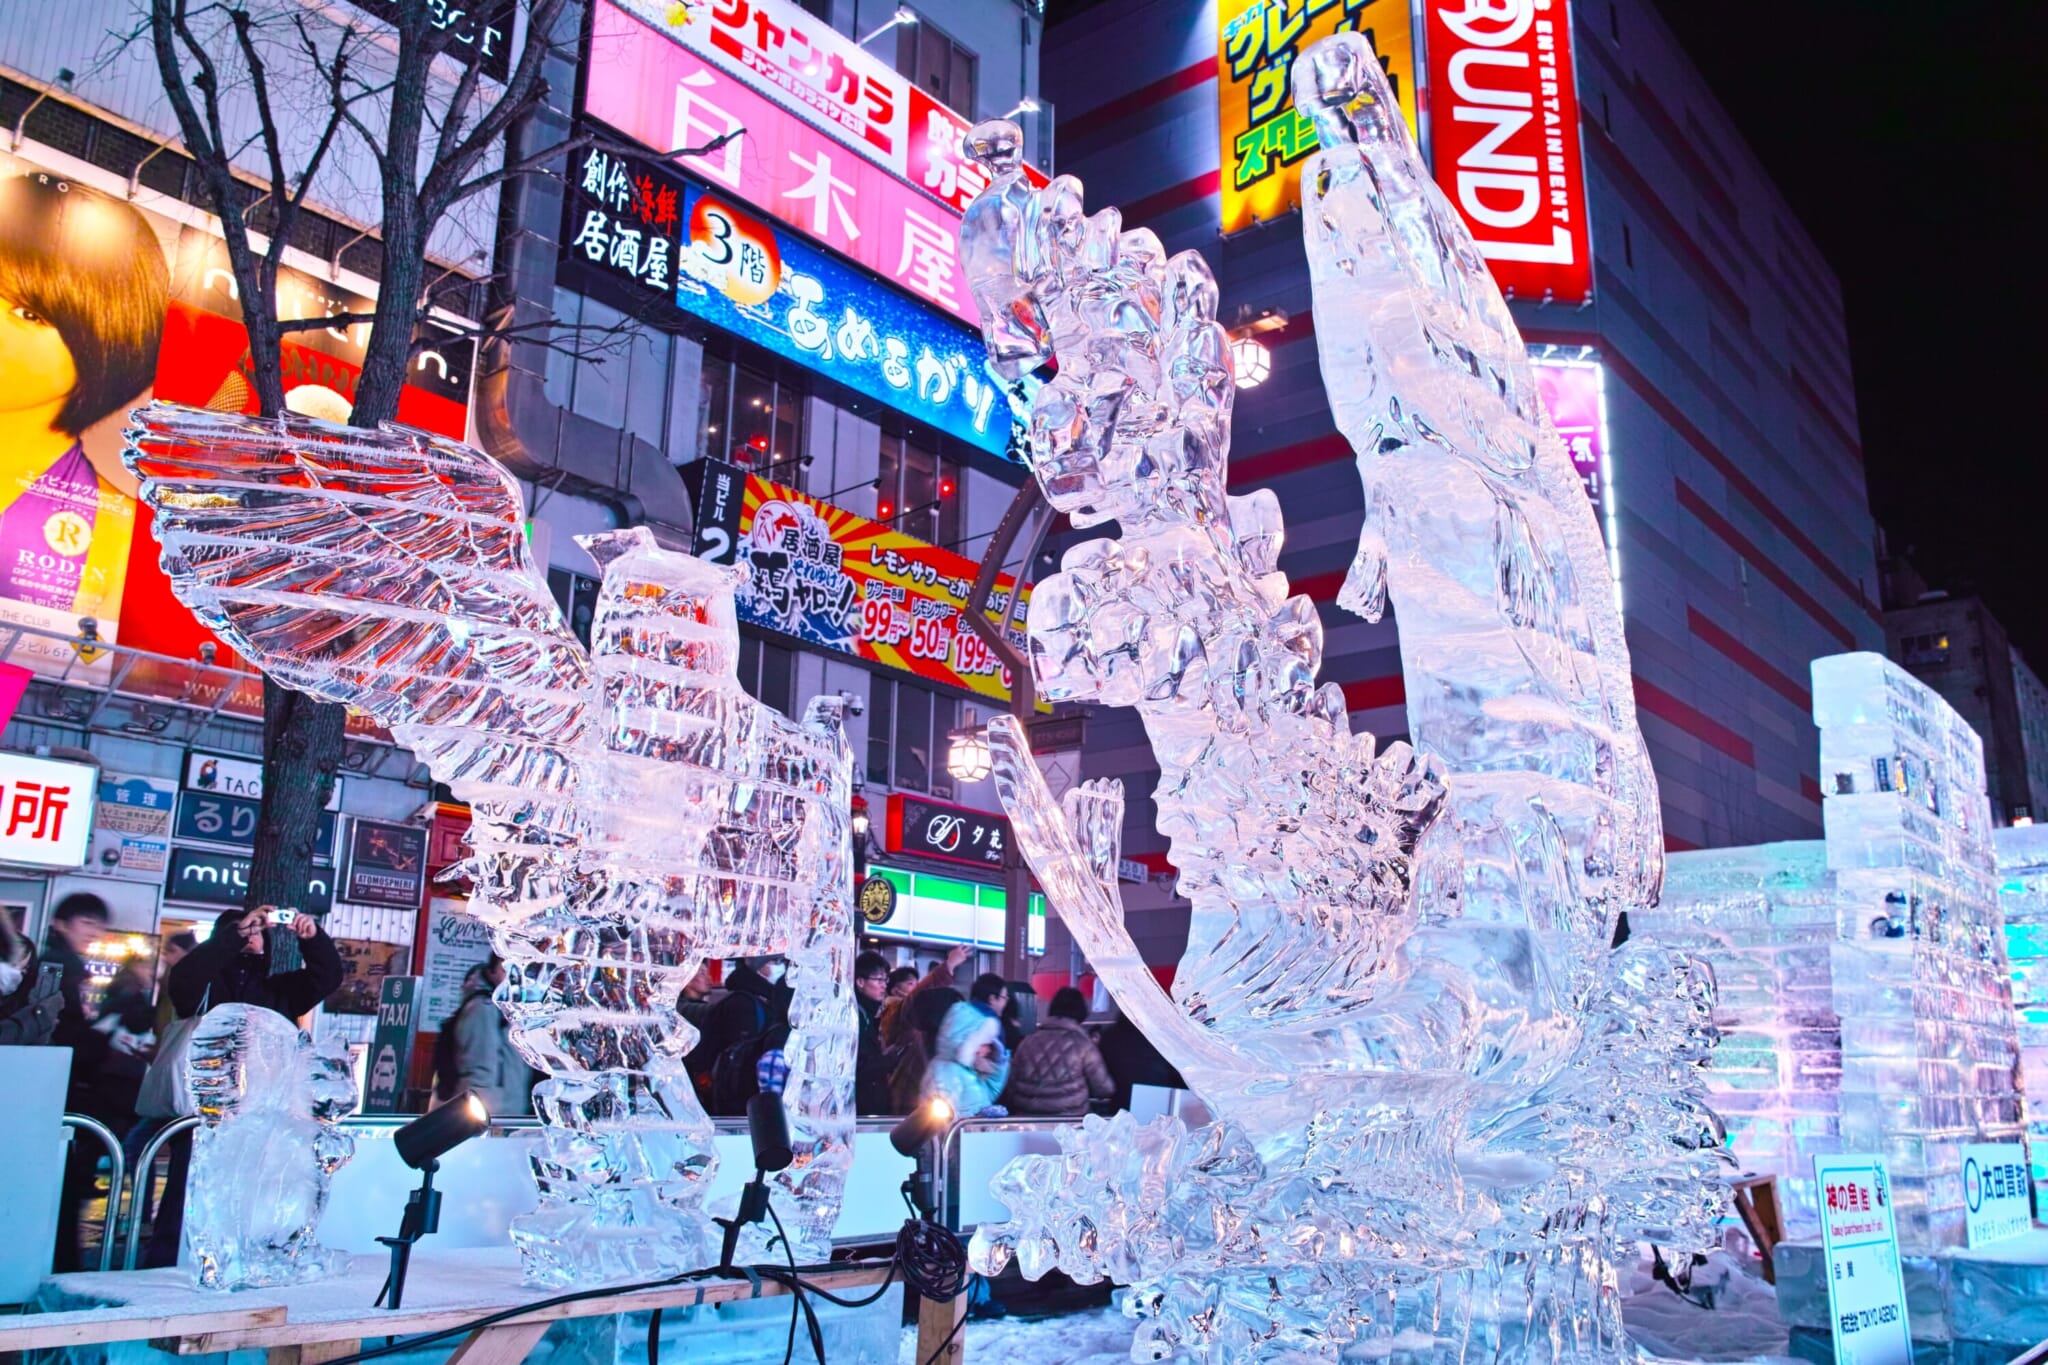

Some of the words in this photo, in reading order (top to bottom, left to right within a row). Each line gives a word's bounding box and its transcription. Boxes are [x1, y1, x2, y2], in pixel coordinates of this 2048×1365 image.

[711, 0, 894, 126] ジャンカラ
[741, 47, 867, 138] ジャンボカラオケ広場
[1536, 20, 1569, 223] ENTERTAINMENT
[581, 148, 678, 237] 創作海鮮
[672, 69, 961, 311] 白木屋
[573, 210, 669, 291] 居酒屋
[702, 212, 767, 285] 3階
[712, 474, 731, 522] 当ビル
[18, 548, 107, 583] RODIN
[781, 528, 842, 569] 居酒屋
[912, 597, 957, 619] レモンサワー
[115, 788, 158, 808] 管理
[381, 1003, 409, 1027] TAXI
